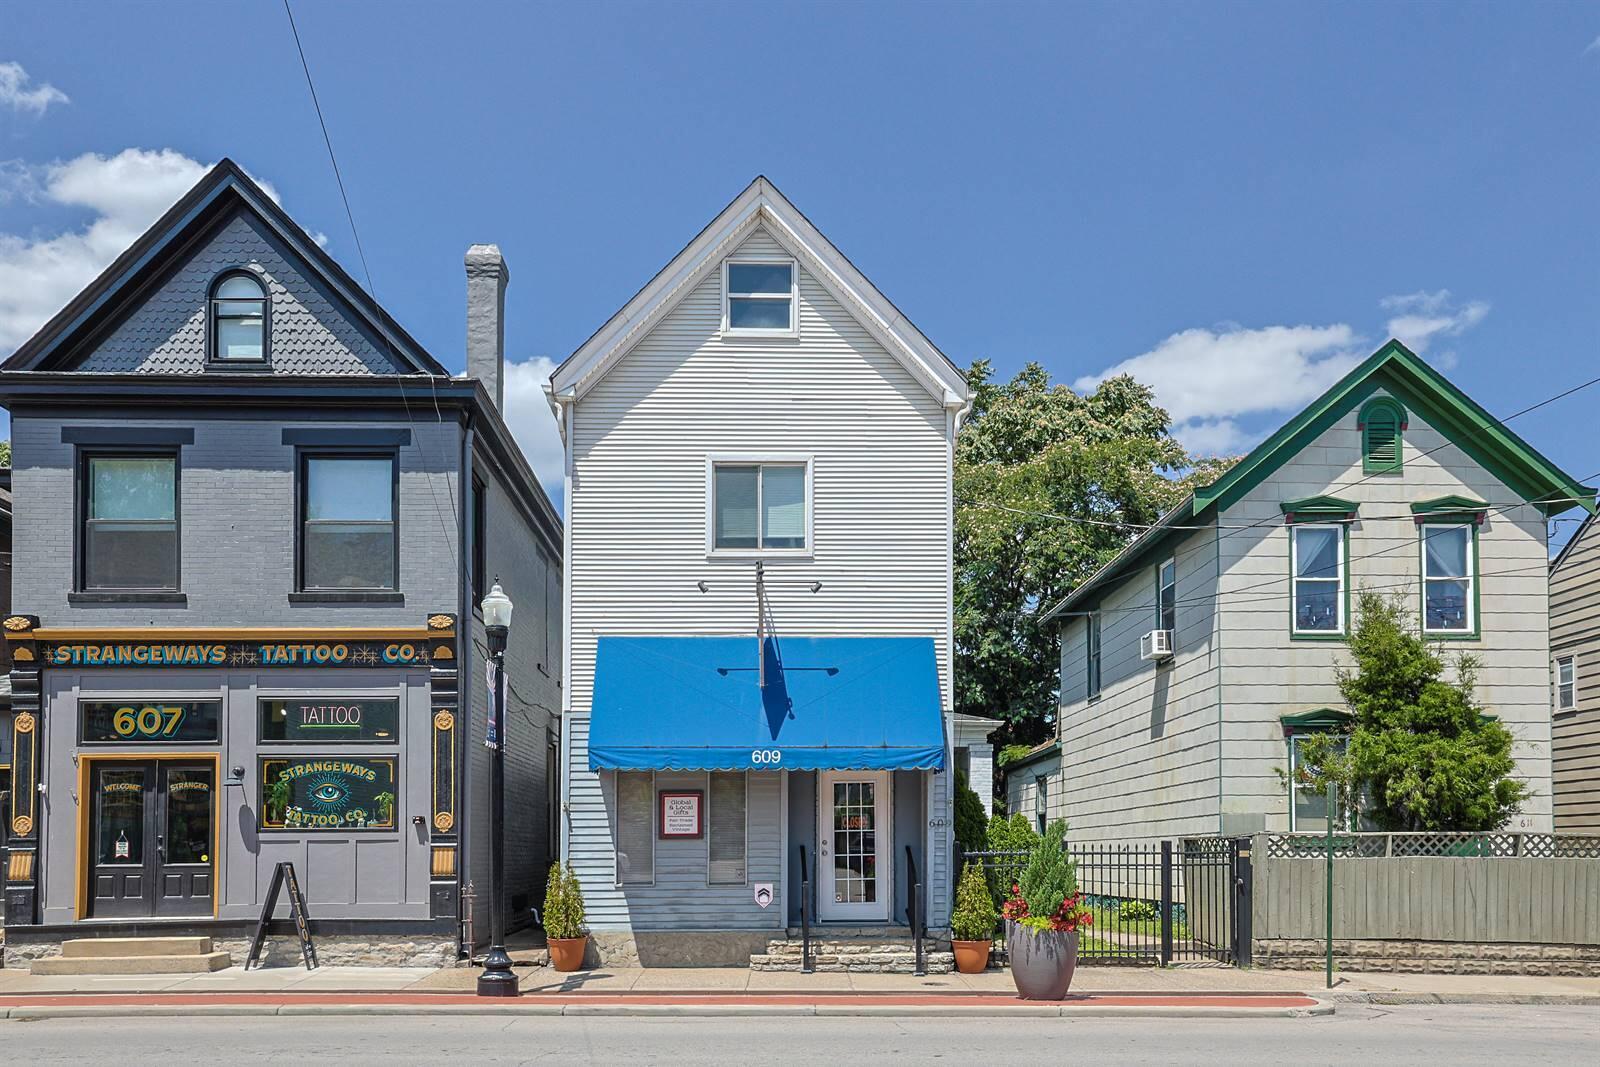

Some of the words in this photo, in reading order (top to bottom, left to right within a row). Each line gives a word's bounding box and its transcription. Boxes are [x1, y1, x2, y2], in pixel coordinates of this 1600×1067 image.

[54, 645, 227, 664] STRANGEWAYS
[260, 645, 348, 664] TATTOO
[383, 644, 419, 663] CO.
[113, 707, 187, 738] 607
[300, 706, 361, 724] TATTOO
[751, 750, 781, 763] 609
[279, 761, 377, 782] STRANGEWAYS
[103, 782, 144, 792] WELCOME
[169, 782, 209, 792] STRANGER
[287, 809, 340, 826] TATTOO
[1520, 818, 1533, 828] 611
[286, 864, 309, 942] TATTOO
